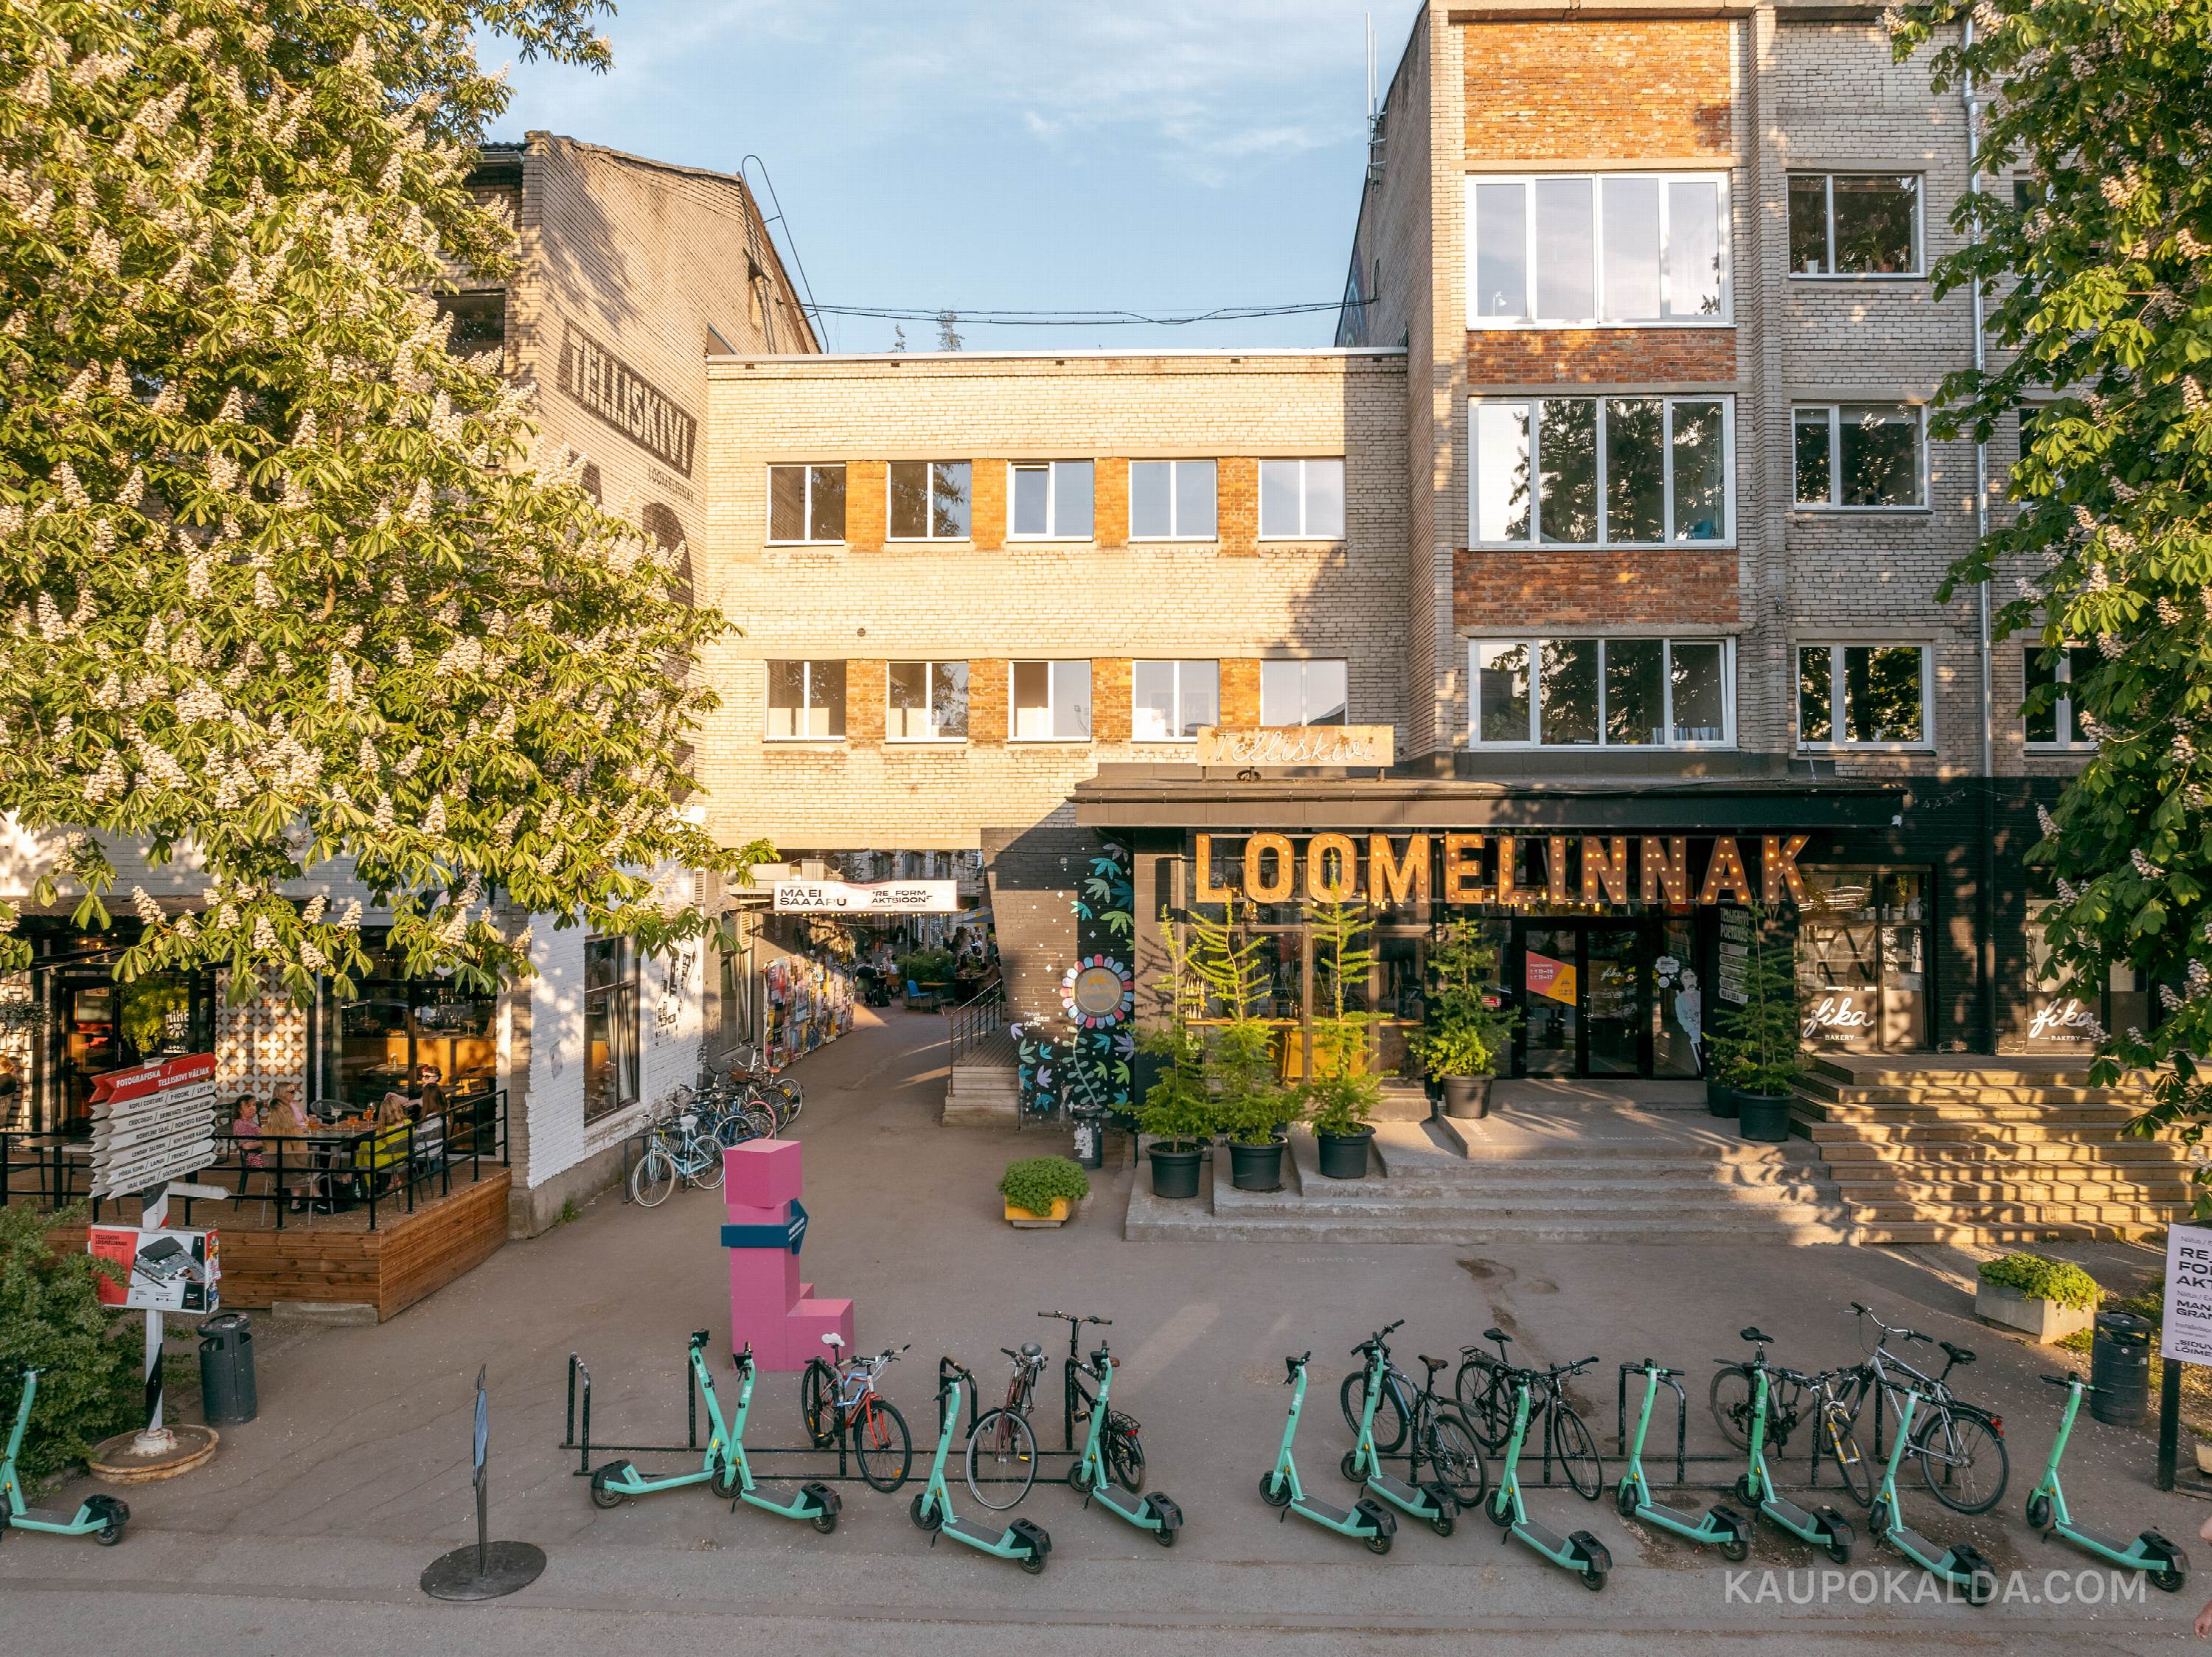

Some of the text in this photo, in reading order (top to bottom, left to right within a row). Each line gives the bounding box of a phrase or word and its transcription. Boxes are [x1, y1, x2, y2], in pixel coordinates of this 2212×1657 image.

[1196, 833, 1810, 906] LOOMELINNAK
[779, 897, 811, 906] SAA
[780, 889, 822, 897] MA EI
[1802, 997, 1876, 1038] fika
[2028, 997, 2094, 1039] fika
[116, 1069, 161, 1088] FOTOGRAFISKA
[158, 1066, 210, 1088] TELLISKIVI VÄLJAK
